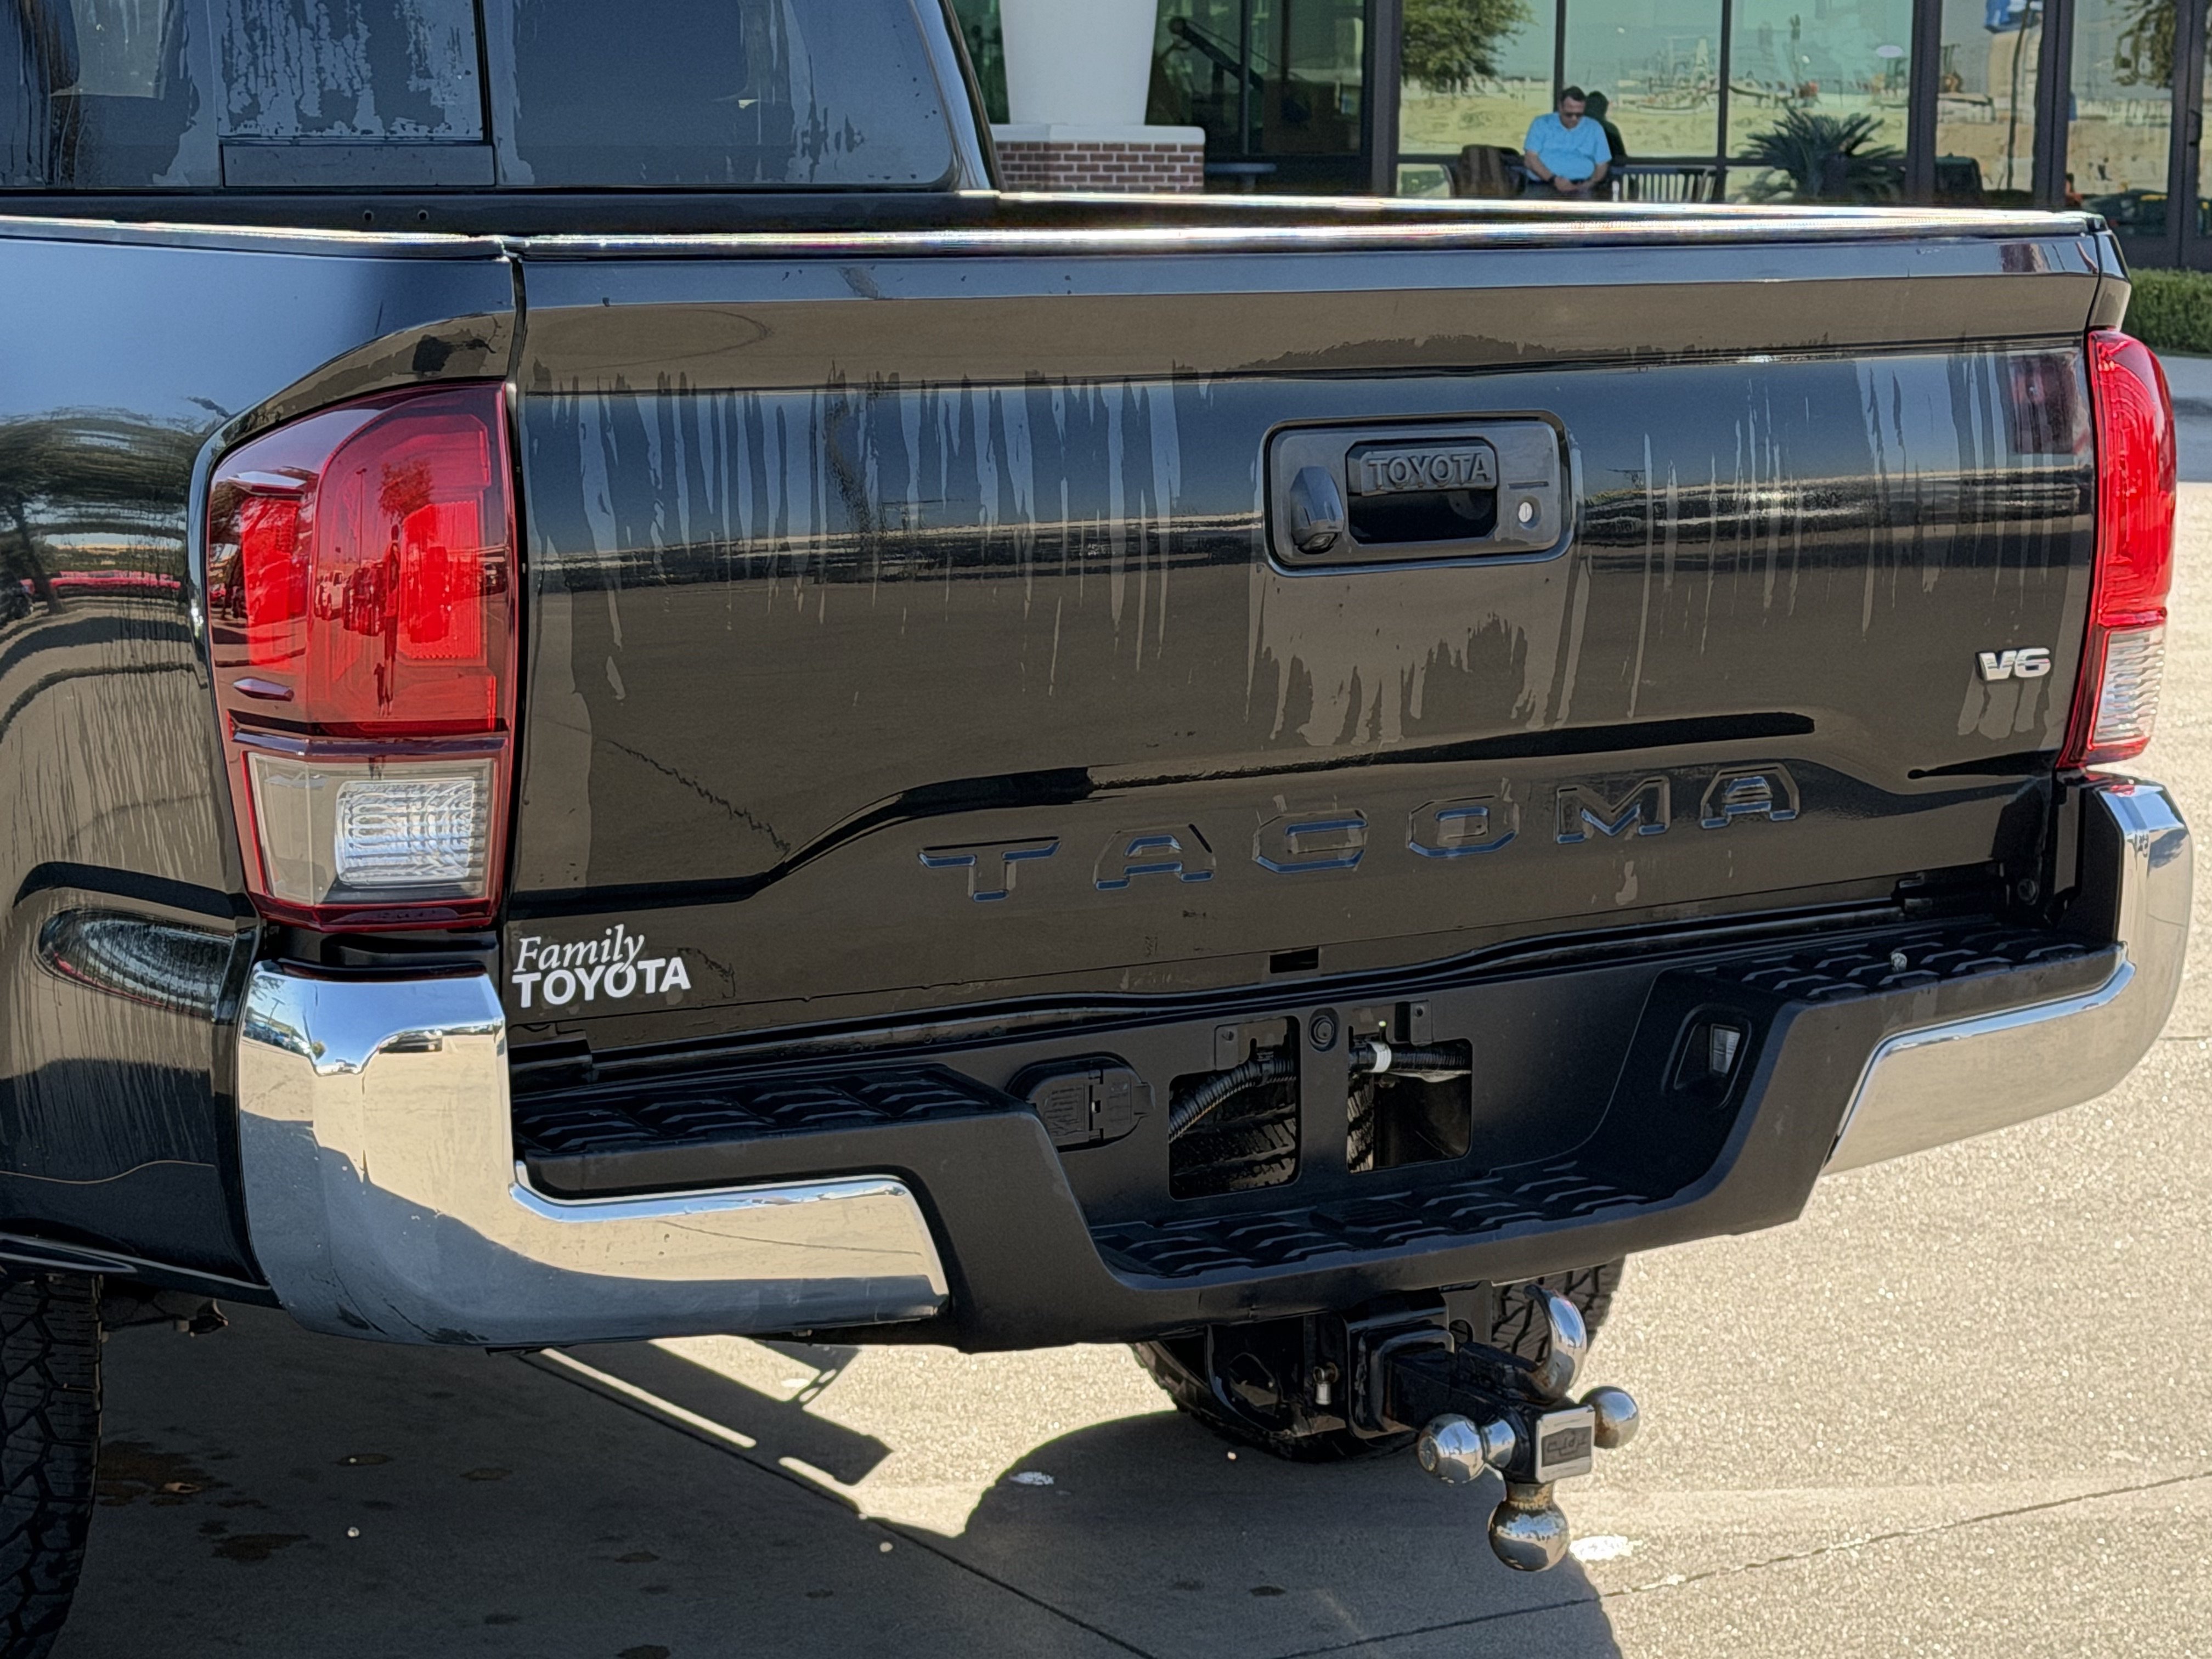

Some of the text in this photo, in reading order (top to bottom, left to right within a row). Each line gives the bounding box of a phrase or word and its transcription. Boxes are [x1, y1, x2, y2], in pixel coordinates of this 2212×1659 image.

[1368, 453, 1491, 487] TOYOTA
[1977, 647, 2051, 681] V6
[918, 763, 1800, 902] TACOMA
[513, 923, 645, 973] Family
[512, 956, 691, 1008] TOYOTA
